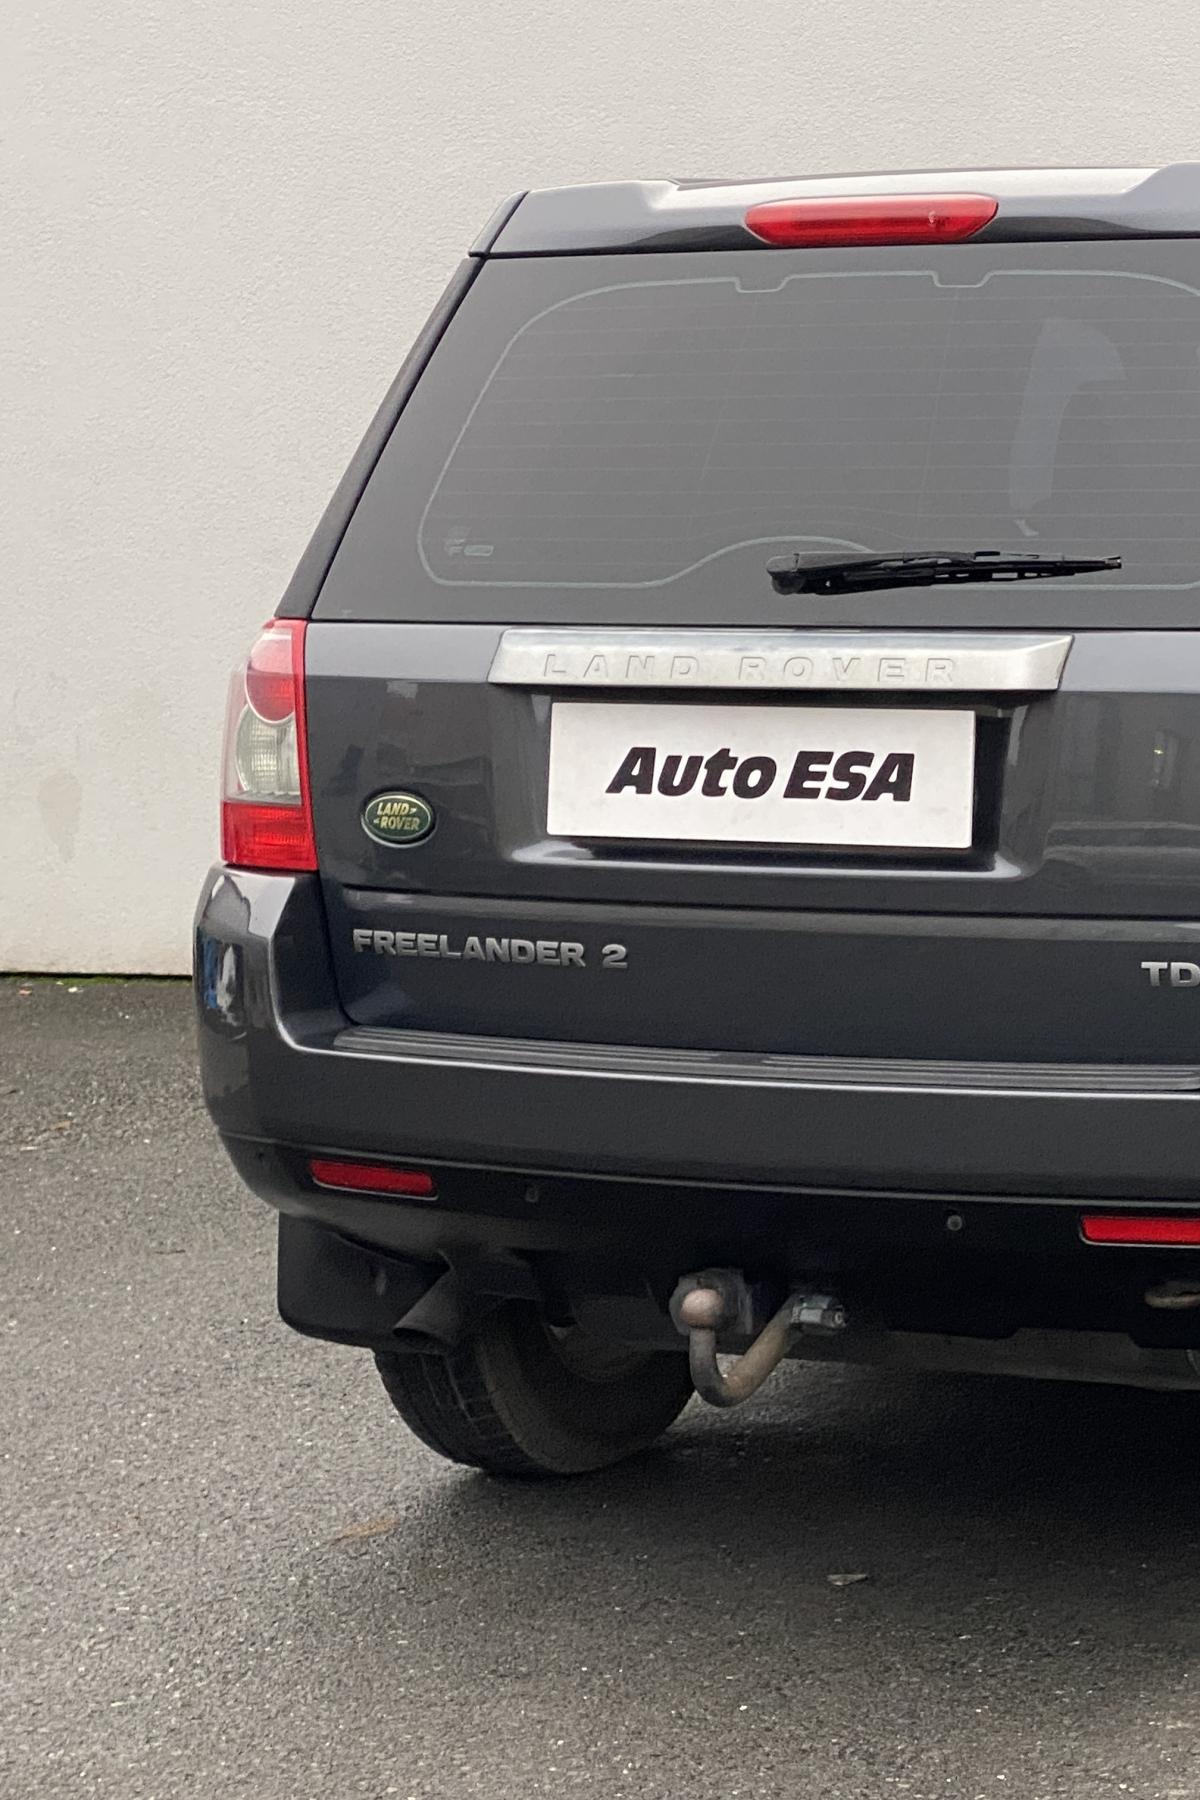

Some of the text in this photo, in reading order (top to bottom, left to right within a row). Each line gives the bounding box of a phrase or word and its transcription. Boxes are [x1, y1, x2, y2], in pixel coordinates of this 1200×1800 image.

[544, 653, 957, 684] LAND ROVER
[605, 746, 916, 803] Auto ESA
[377, 802, 410, 816] LAND
[379, 815, 421, 831] ROVER
[352, 928, 628, 969] FREELANDER 2
